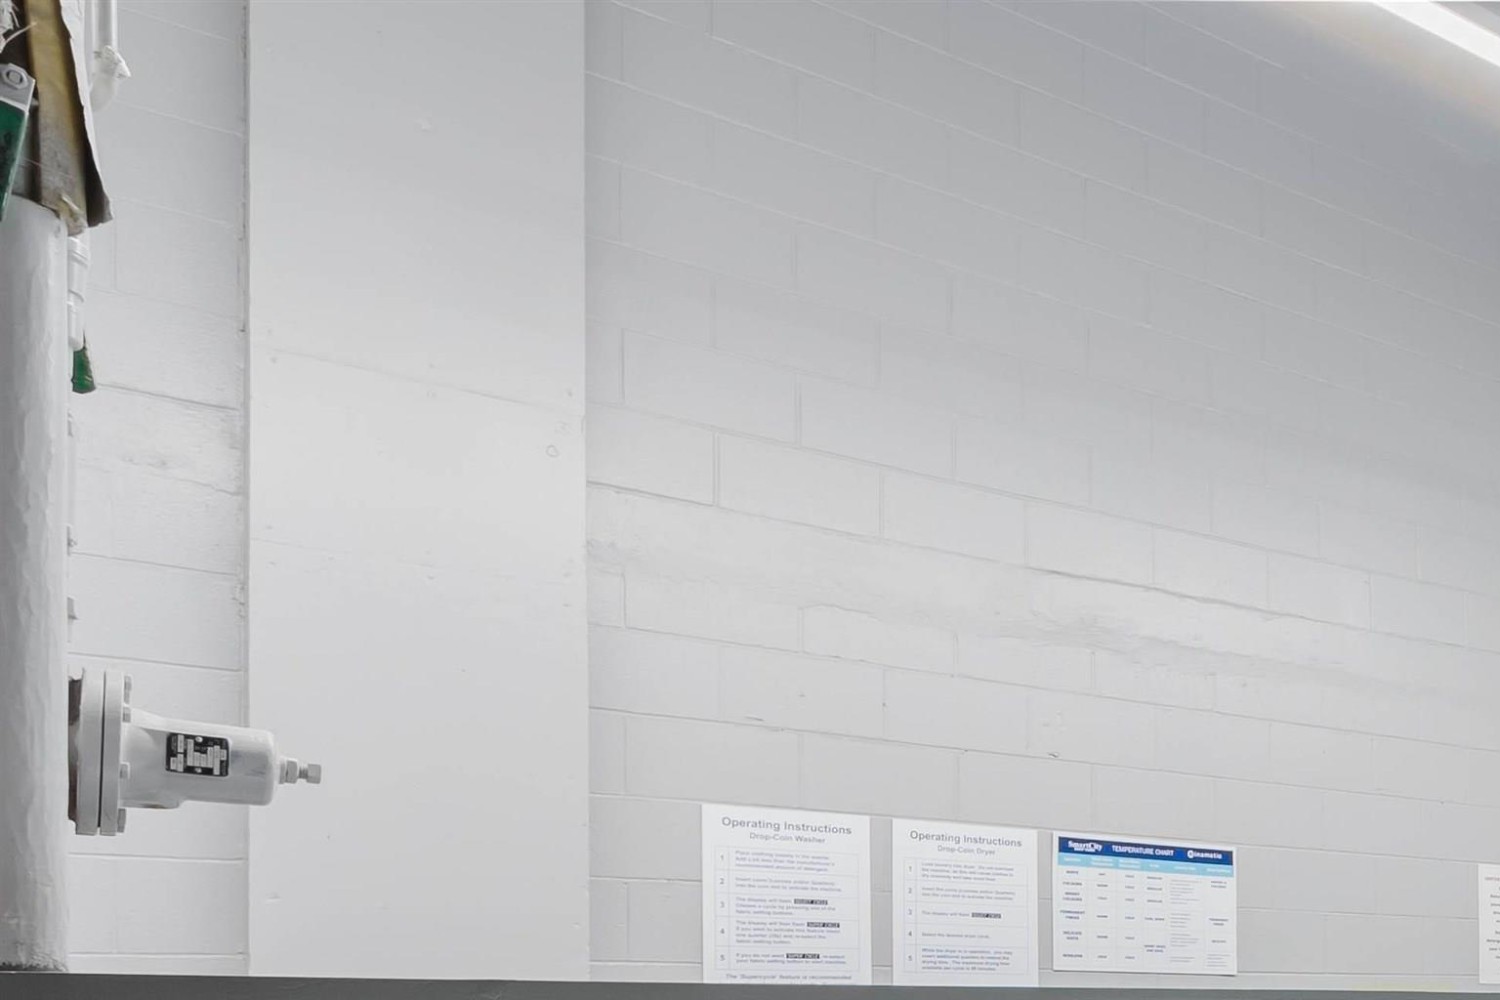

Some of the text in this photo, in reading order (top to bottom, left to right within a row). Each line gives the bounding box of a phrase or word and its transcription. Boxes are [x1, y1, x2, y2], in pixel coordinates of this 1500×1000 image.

[721, 816, 853, 835] Operating Instructions
[749, 832, 826, 844] Drop-Coin Washer
[909, 830, 1023, 847] Operating Instructions
[937, 844, 996, 856] Drop-Coin Dryer
[1111, 844, 1155, 856] TEMPERATURE
[1154, 848, 1175, 857] CHART
